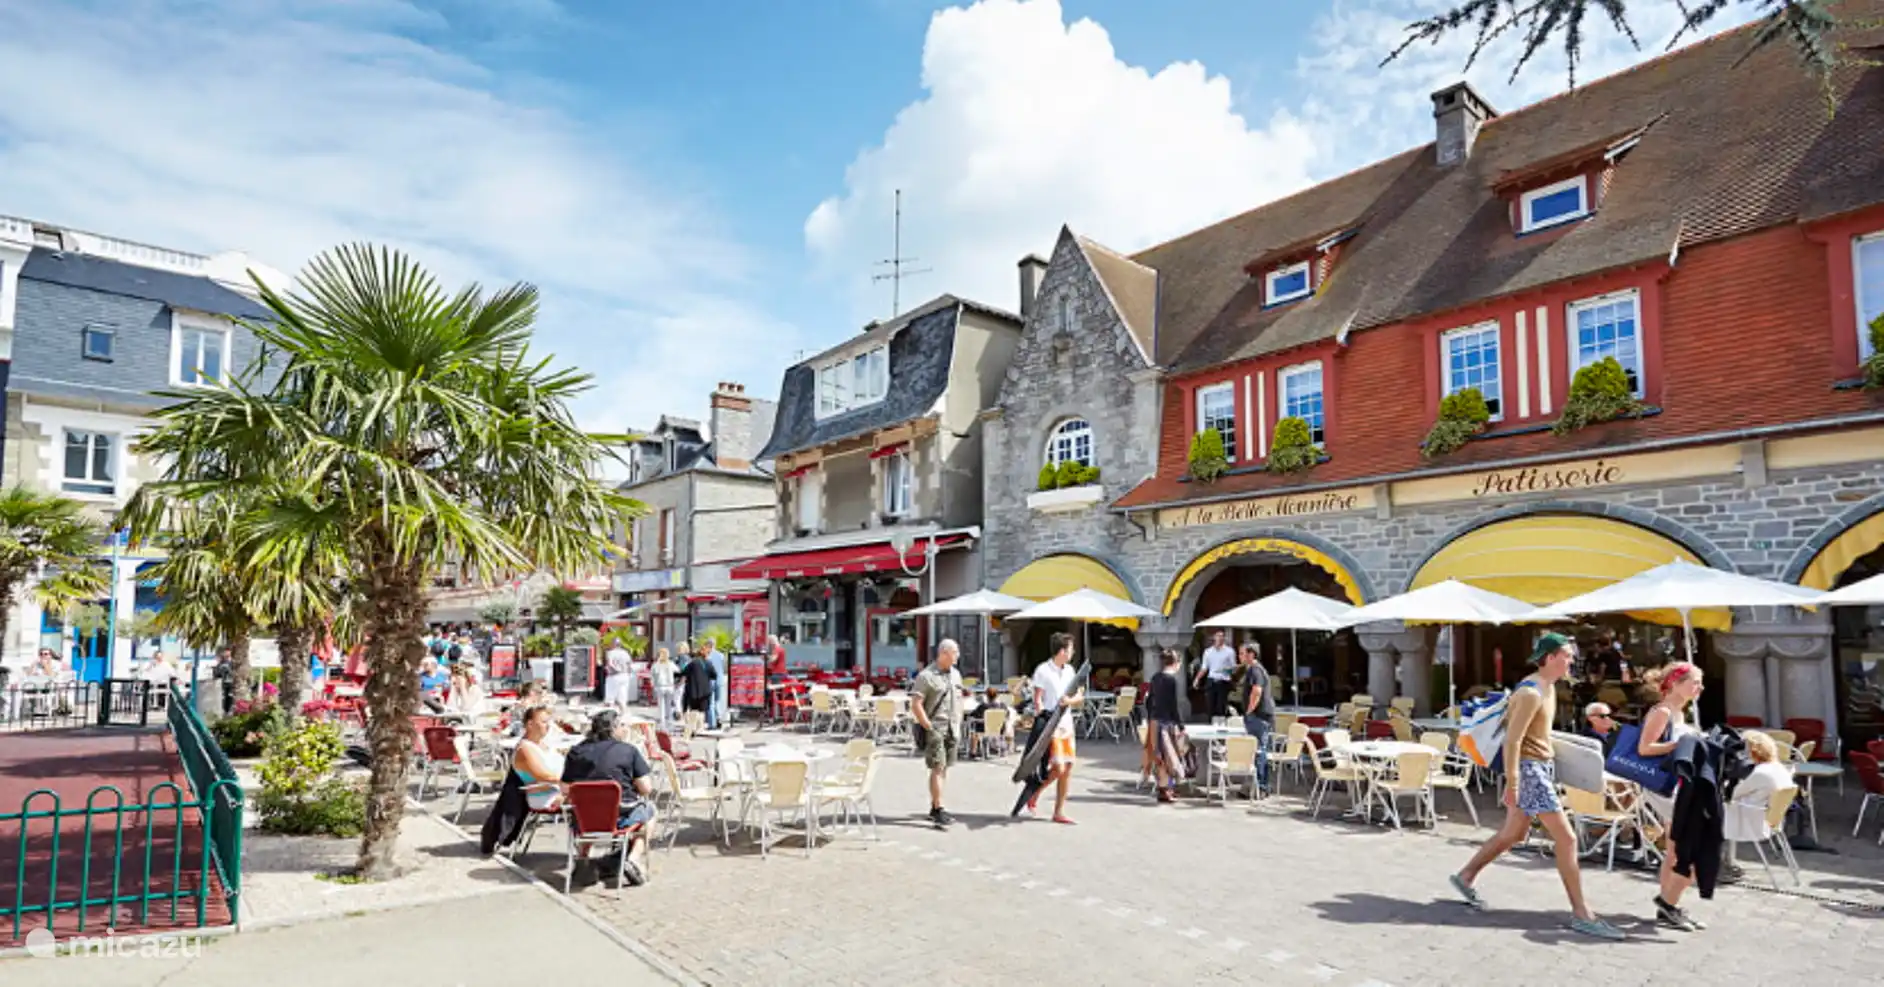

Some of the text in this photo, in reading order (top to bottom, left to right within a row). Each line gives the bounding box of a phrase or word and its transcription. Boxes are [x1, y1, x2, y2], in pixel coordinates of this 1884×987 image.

[1472, 459, 1623, 496] Patisserie
[1197, 507, 1212, 524] la
[1219, 502, 1264, 521] Belle
